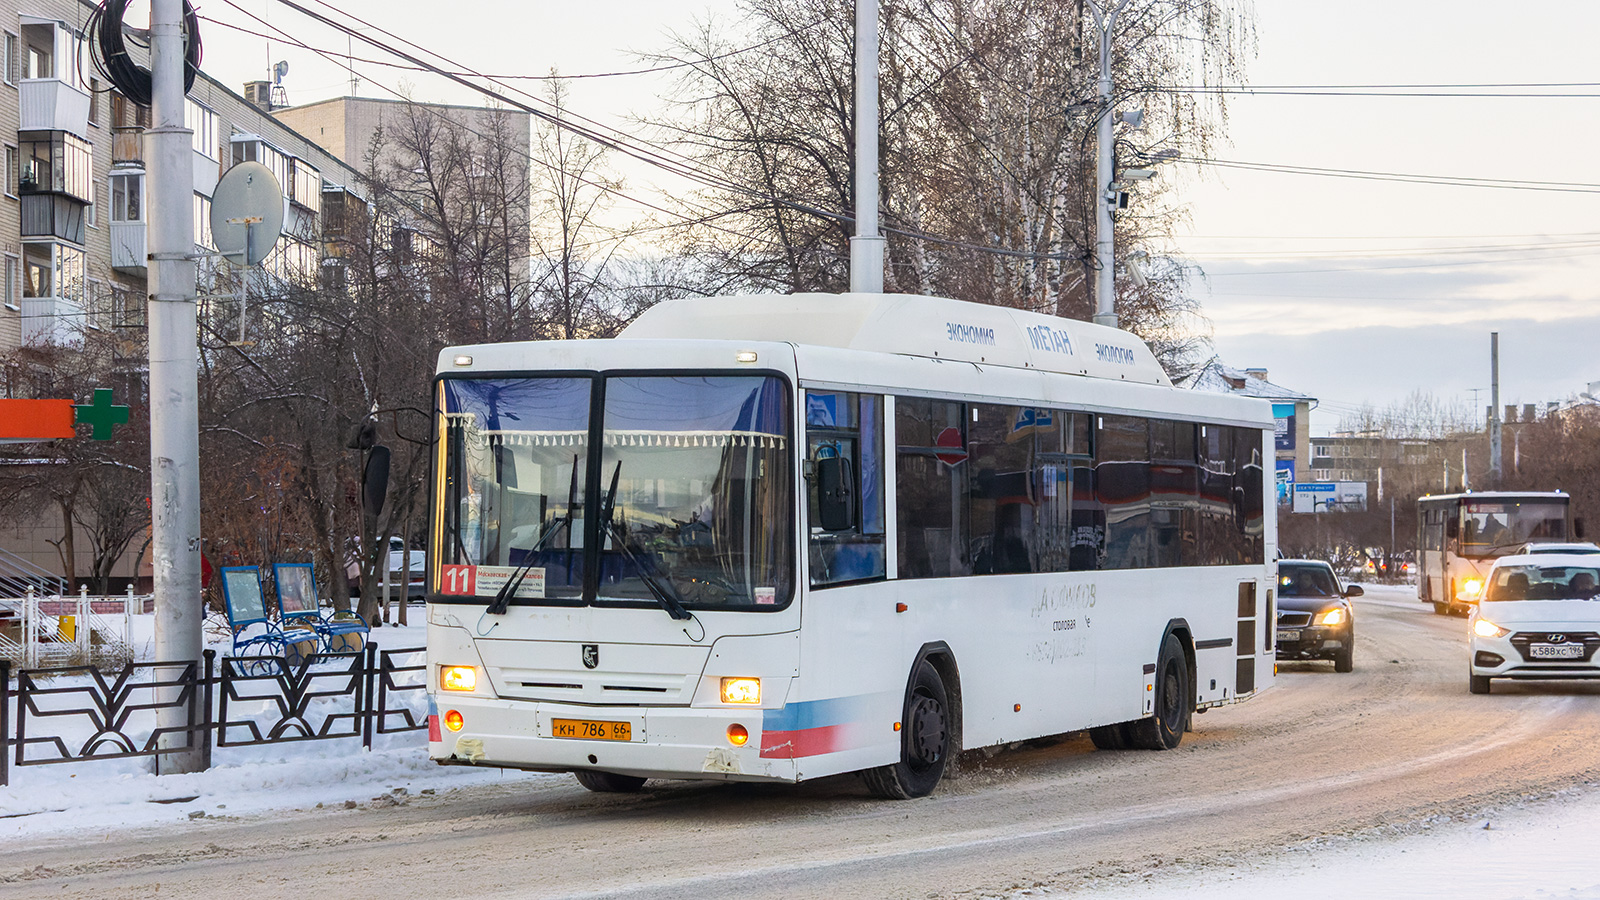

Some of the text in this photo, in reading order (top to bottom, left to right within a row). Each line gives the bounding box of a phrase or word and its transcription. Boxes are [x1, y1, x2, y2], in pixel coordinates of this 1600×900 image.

[946, 322, 996, 346] ЭКОНОМИЯ
[1095, 343, 1135, 366] ЭКОЛОГИЯ
[446, 567, 469, 592] 11
[559, 723, 626, 736] КН 786 66
